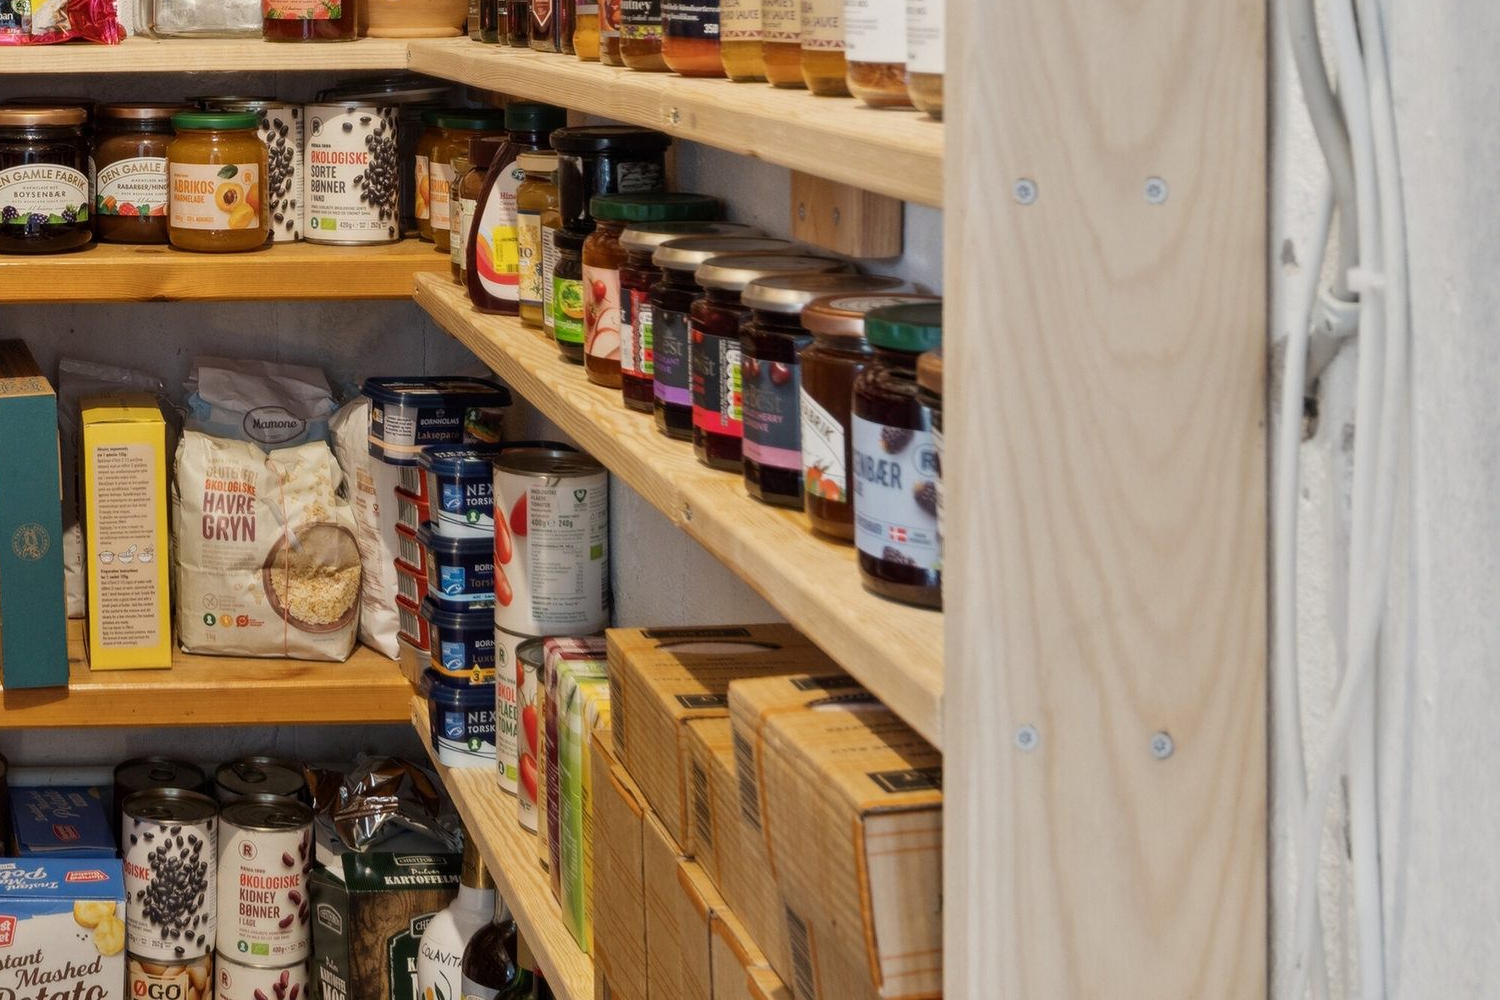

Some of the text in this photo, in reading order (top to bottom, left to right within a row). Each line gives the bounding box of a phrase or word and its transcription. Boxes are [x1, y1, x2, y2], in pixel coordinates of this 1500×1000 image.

[310, 150, 368, 165] ØKOLOGISKE
[12, 168, 53, 183] GAMLE
[55, 169, 86, 192] FABRIK
[101, 162, 162, 186] DEN GAMLE
[310, 165, 337, 179] SORTE
[13, 190, 66, 199] BOYSENBÆR
[173, 180, 215, 195] ABRIKOS
[310, 180, 346, 194] BØNNER
[313, 194, 325, 203] VAND
[252, 417, 298, 430] Mamone
[420, 417, 460, 427] BORNHOLMS
[204, 478, 257, 497] ØKOLOGISKE
[202, 491, 256, 515] HAVRE
[201, 515, 256, 543] GRYN
[239, 873, 300, 890] ØKOLOGISKE
[239, 887, 277, 905] KIDNEY
[239, 902, 281, 919] BØNNER
[242, 917, 257, 928] LAGE
[14, 954, 104, 991] Mashed
[319, 966, 347, 991] KARTOFFEL
[133, 979, 181, 1000] ØGO
